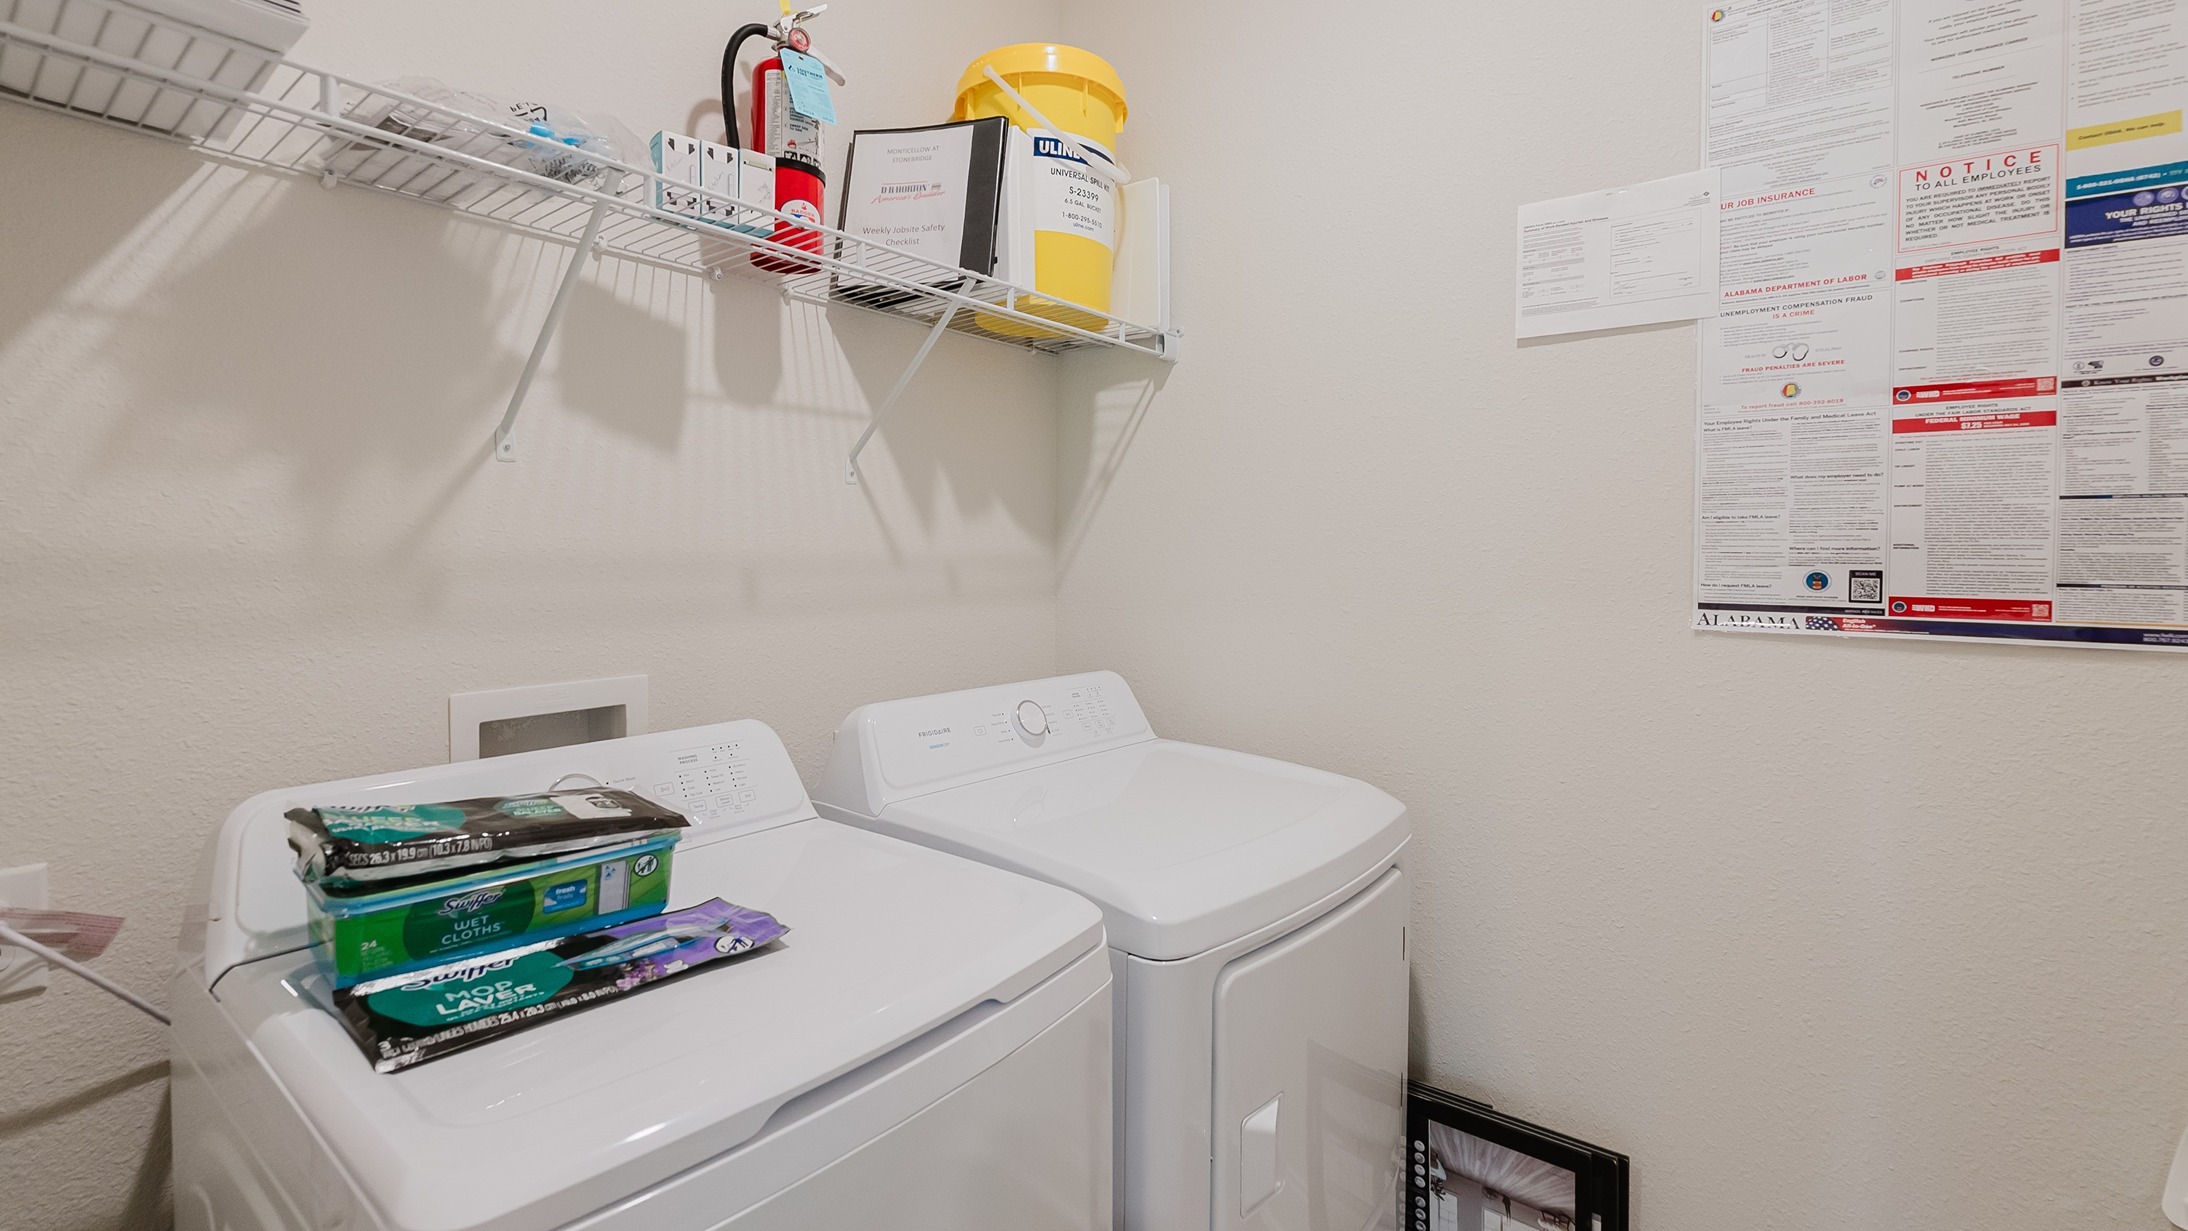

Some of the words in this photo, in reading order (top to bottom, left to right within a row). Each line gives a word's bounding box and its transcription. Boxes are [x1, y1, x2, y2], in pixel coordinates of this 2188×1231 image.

[887, 146, 930, 154] MONTICELLOW
[892, 154, 932, 163] STONEBRIDGE
[1916, 150, 2042, 182] NOTICE
[1050, 167, 1088, 182] UNIVERSAL
[1090, 176, 1103, 189] SPILL
[1915, 182, 1930, 192] TO
[1934, 178, 1958, 188] ALL
[1962, 164, 2042, 184] EMPLOYEES
[1069, 186, 1099, 202] S-23399
[1933, 194, 1974, 205] SUPERVISOR
[1990, 186, 2024, 196] PERSONAL
[1934, 189, 1967, 199] REQUIRED
[1978, 180, 2022, 192] IMMEDIATELY
[2023, 176, 2050, 184] REPORT
[1737, 198, 1754, 208] JOB
[1757, 188, 1816, 204] INSURANCE
[1952, 200, 1982, 208] HAPPENS
[1918, 219, 1944, 227] MATTER
[1968, 212, 1990, 220] SLIGHT
[1934, 207, 1982, 218] OCCUPATIONAL
[2105, 208, 2138, 220] YOUR
[2140, 202, 2184, 215] RIGHTS
[862, 226, 891, 235] Weekly
[892, 224, 920, 234] Jobsite
[922, 224, 946, 232] Safety
[1072, 222, 1094, 232] uline.com
[1906, 226, 1936, 236] WHETHER
[1967, 218, 1996, 226] MEDICAL
[2000, 212, 2040, 222] TREATMENT
[886, 238, 920, 246] Checklist
[1724, 288, 1763, 298] ALABAMA
[1766, 280, 1822, 292] DEPARTMENT
[1838, 274, 1868, 283] LABOR
[1720, 306, 1780, 318] UNEMPLOYMENT
[1782, 298, 1843, 310] COMPENSATION
[1845, 294, 1873, 303] FRAUD
[1790, 310, 1816, 318] CRIME
[1961, 422, 1982, 430] $7.25
[1697, 612, 1800, 630] ALABAMA
[918, 727, 952, 738] FRIGIDAIRE
[370, 852, 390, 864] 26.3
[397, 847, 416, 861] 19.9
[429, 843, 450, 858] (10.3
[456, 841, 470, 853] 7.8
[556, 886, 576, 895] fresh
[438, 889, 505, 916] Swiffer
[454, 915, 490, 932] WET
[441, 922, 501, 945] CLOTHS
[361, 940, 378, 950] 24
[436, 983, 537, 1016] LAVER
[445, 980, 513, 1002] MOP
